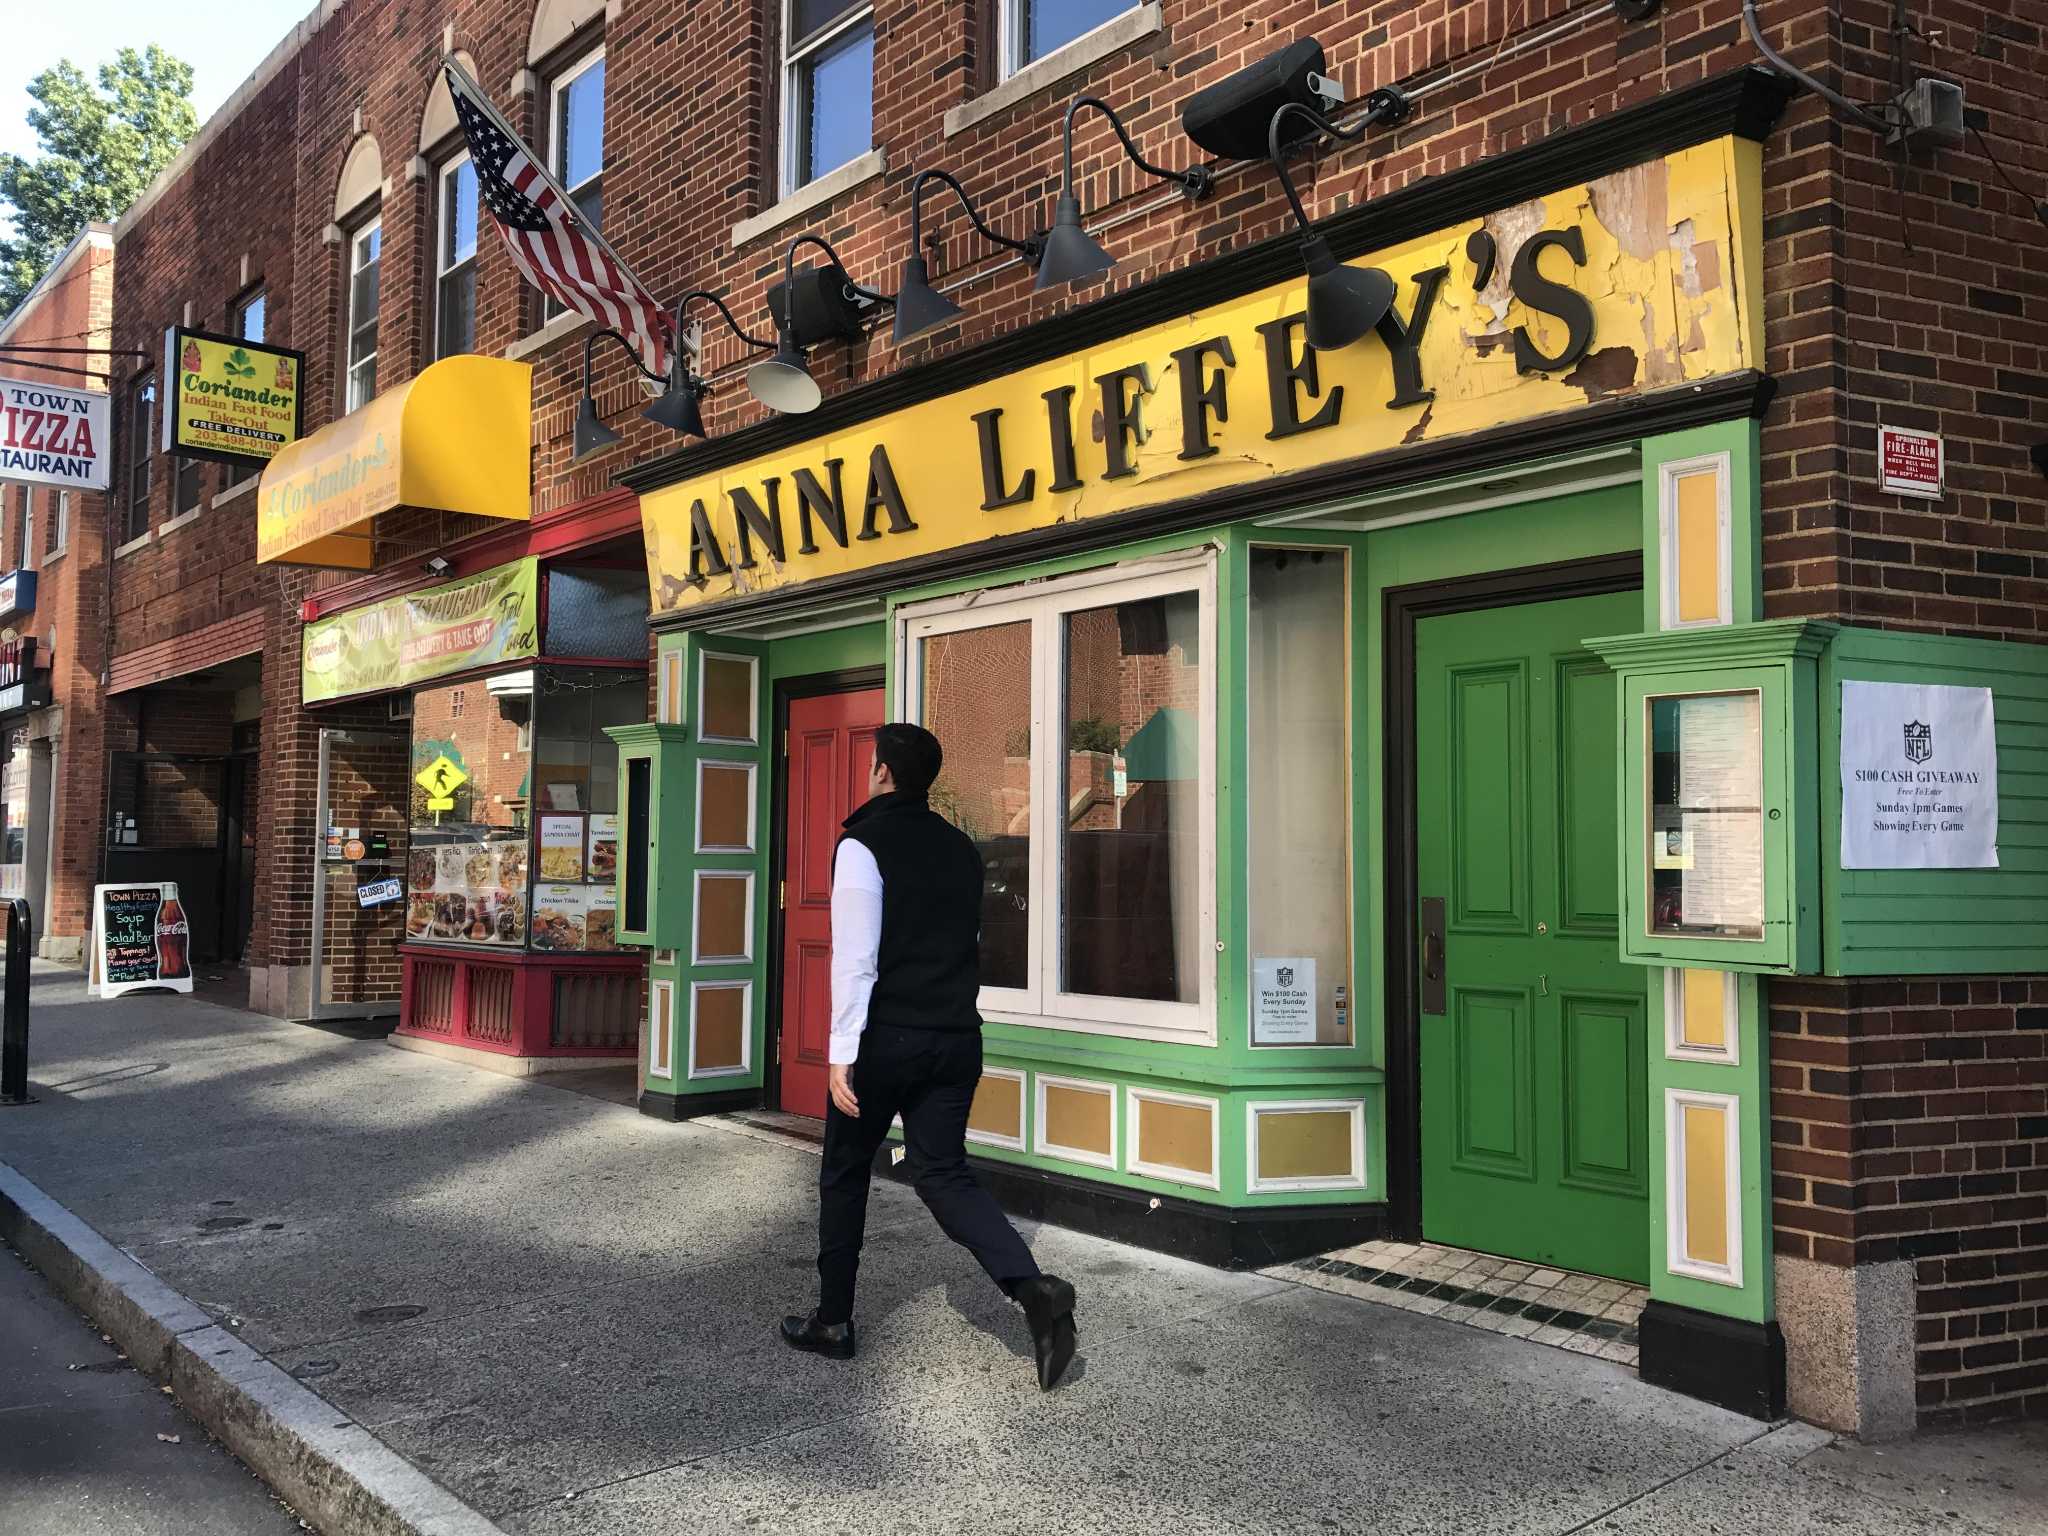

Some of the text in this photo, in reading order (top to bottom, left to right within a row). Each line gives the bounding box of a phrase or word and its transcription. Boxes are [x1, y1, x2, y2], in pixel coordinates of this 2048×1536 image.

[184, 373, 292, 408] Coriander
[11, 389, 91, 414] TOWN
[184, 393, 291, 421] Indian Fast Food
[686, 225, 1595, 582] ANNA LIFFEY'S
[0, 390, 96, 458] IZZA
[208, 410, 269, 430] Take-Out
[193, 420, 281, 441] FREE DELIVERY
[195, 430, 280, 452] 203-498-0100
[1895, 435, 1928, 446] SPRINKLER
[0, 448, 92, 479] TAURANT
[1887, 457, 1903, 465] WHEN
[453, 627, 473, 648] TAKE
[473, 622, 491, 644] OUT
[1906, 738, 1930, 759] NFL
[1855, 769, 1979, 783] $100 CASH GIVEAWAY
[1897, 787, 1913, 796] Free
[1876, 802, 1963, 815] Sunday 1pm Games
[1874, 820, 1964, 833] Showing Every Game
[107, 892, 130, 902] TOWN
[359, 884, 385, 899] CLOSED
[116, 913, 144, 926] Soup
[106, 931, 153, 945] Salad Bar
[1278, 975, 1291, 985] NFL
[1263, 998, 1306, 1006] Every Sunday
